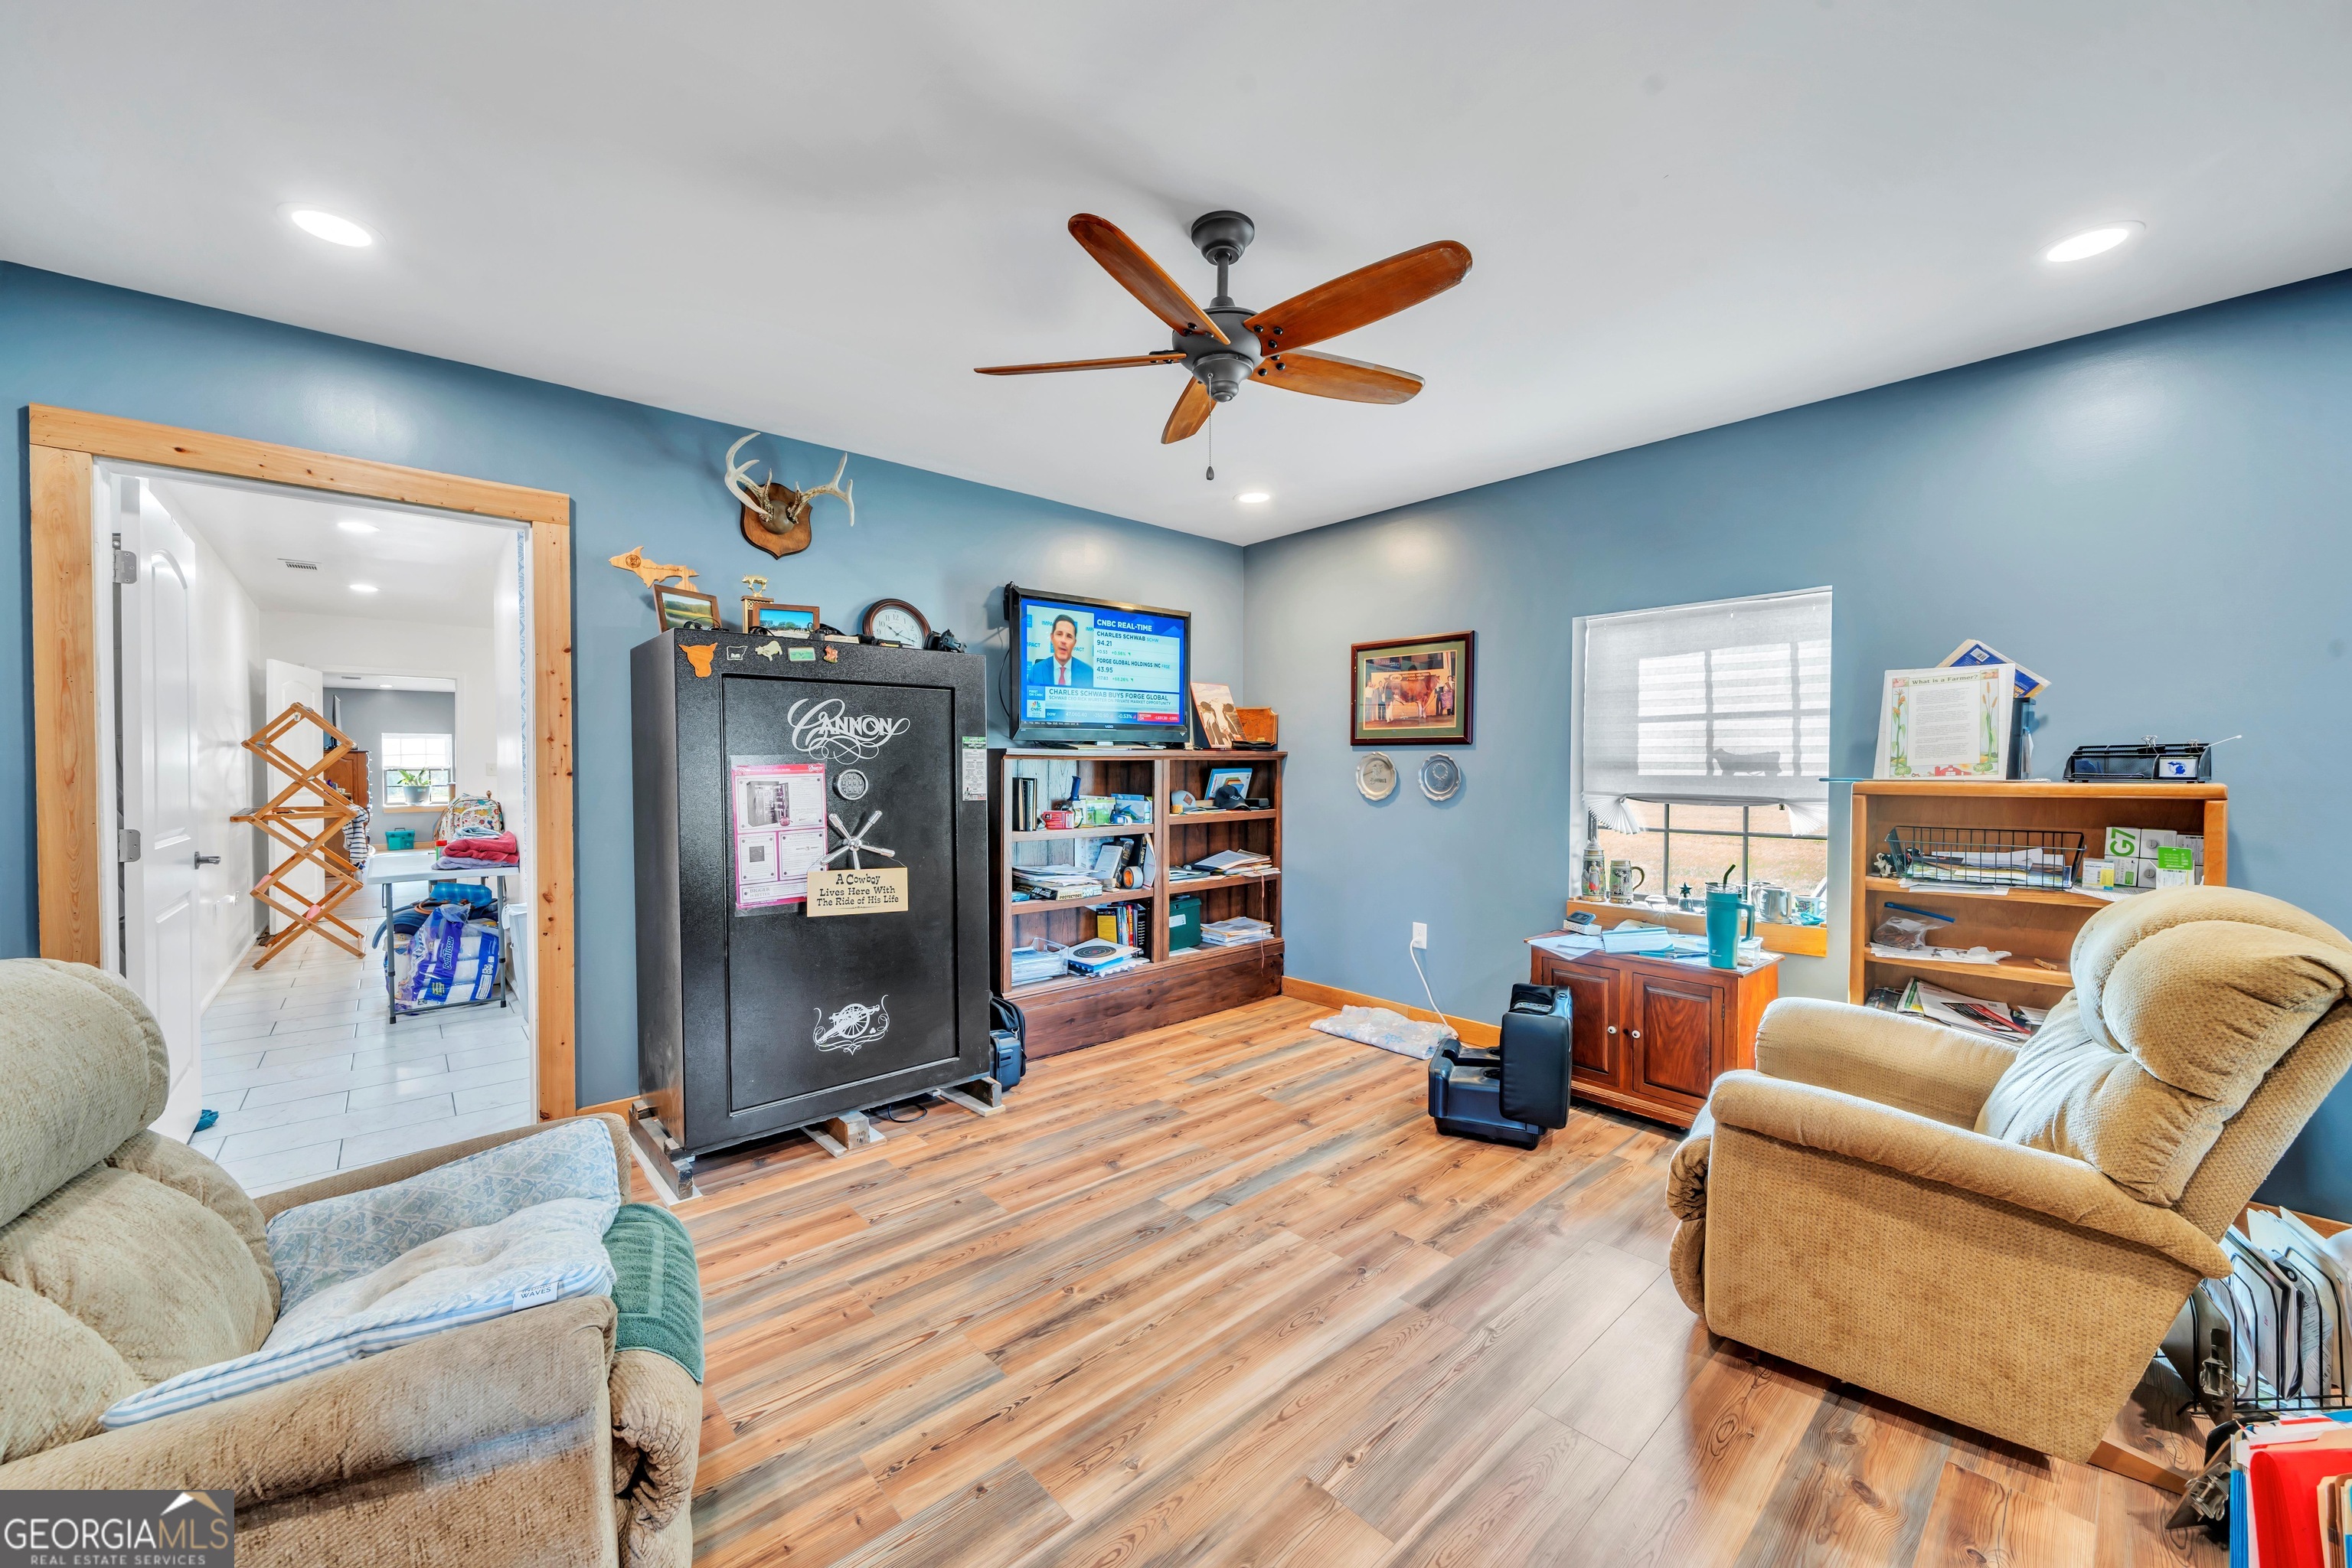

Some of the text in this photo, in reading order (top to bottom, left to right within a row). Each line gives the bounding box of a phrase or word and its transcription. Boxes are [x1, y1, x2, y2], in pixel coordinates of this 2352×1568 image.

[1096, 619, 1152, 632] CNBC REAL-TIME
[2110, 827, 2136, 856] G7
[836, 874, 880, 885] A Cowboy
[819, 886, 896, 897] Lives Here With
[817, 898, 833, 906] The
[858, 896, 865, 904] of
[884, 894, 899, 903] Life
[521, 1287, 551, 1298] WAVES
